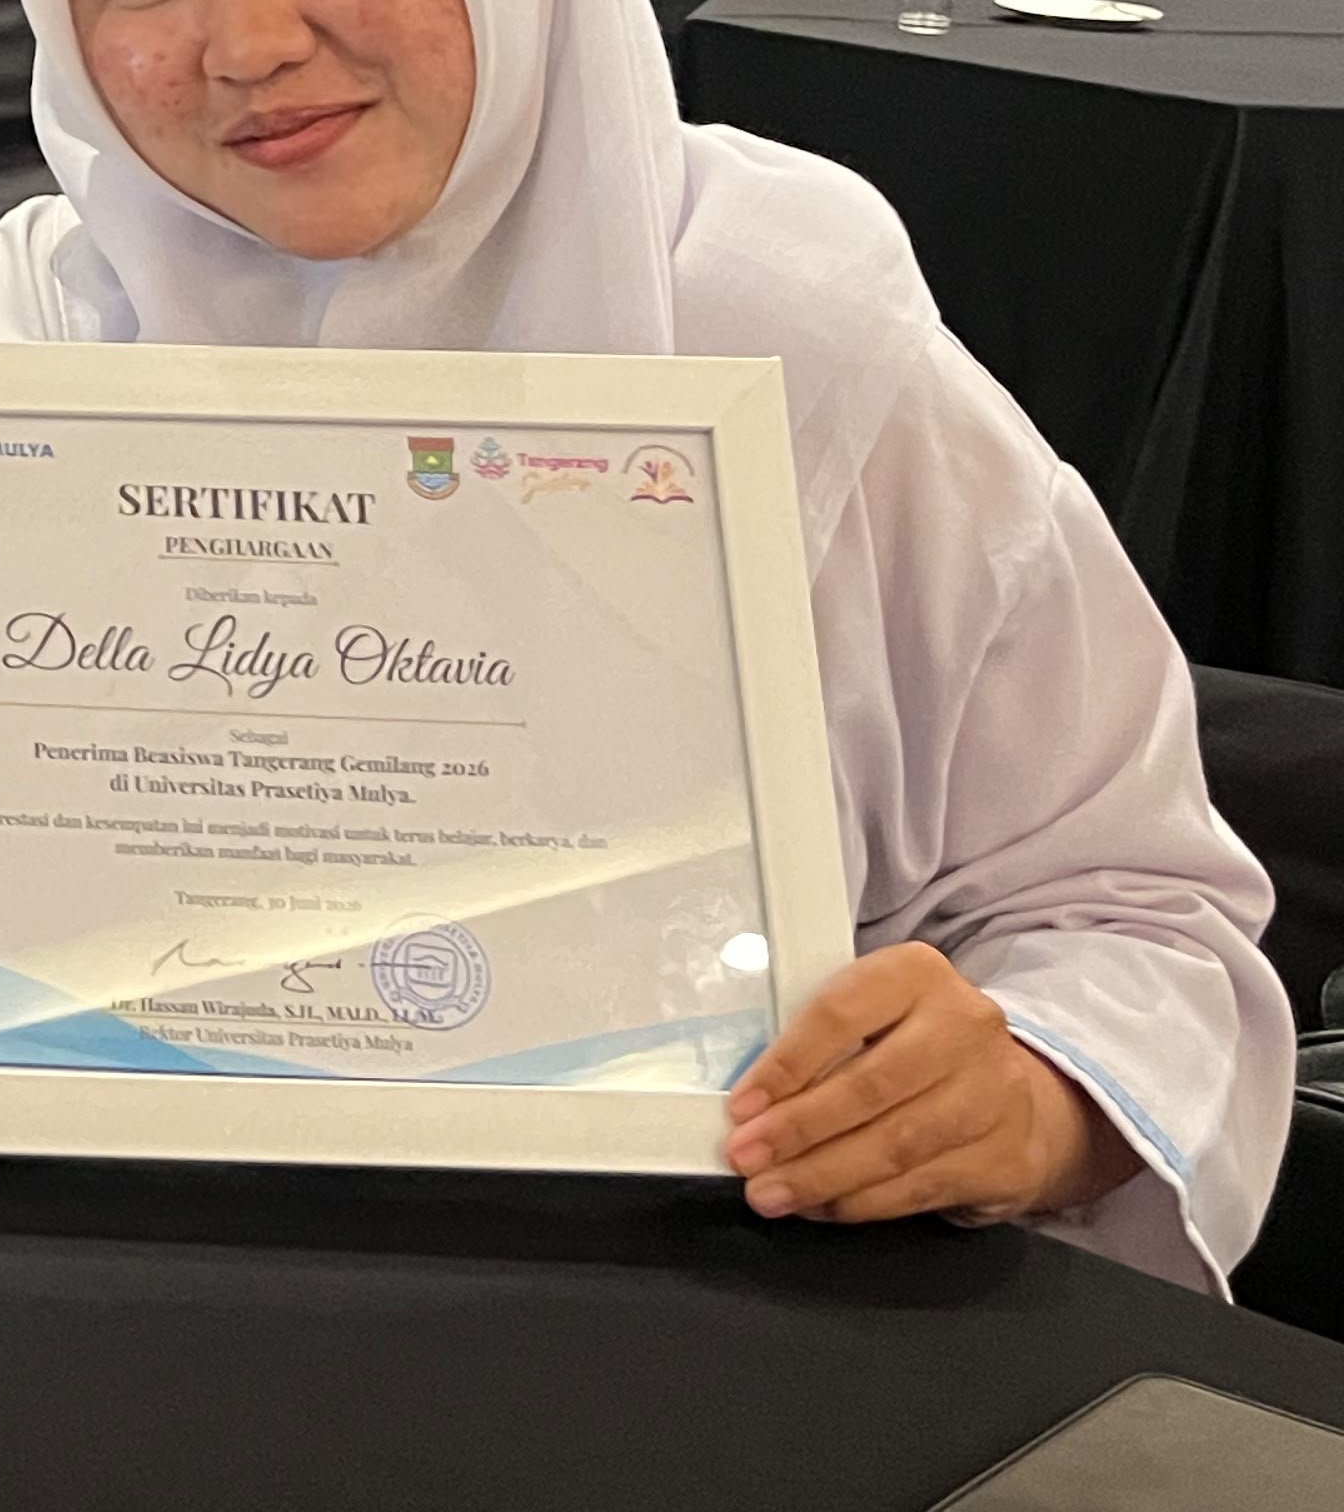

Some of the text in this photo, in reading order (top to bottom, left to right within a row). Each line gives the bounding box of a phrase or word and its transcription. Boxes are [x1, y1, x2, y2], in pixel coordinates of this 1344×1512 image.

[117, 482, 377, 525] SERTIFIKAT
[164, 535, 334, 560] PENGHARGAAN
[1, 611, 517, 699] Della Lidya Oktavia
[33, 741, 490, 778] Penerima Beasiswa Tangerang Gemilang 2026
[109, 773, 417, 807] di Universitas Prasetiya Mulya.
[52, 813, 83, 830] dan
[140, 998, 199, 1016] Hassan
[195, 1027, 285, 1047] Universitas
[288, 1031, 362, 1052] Prasetiya
[364, 1034, 414, 1055] Mulya
